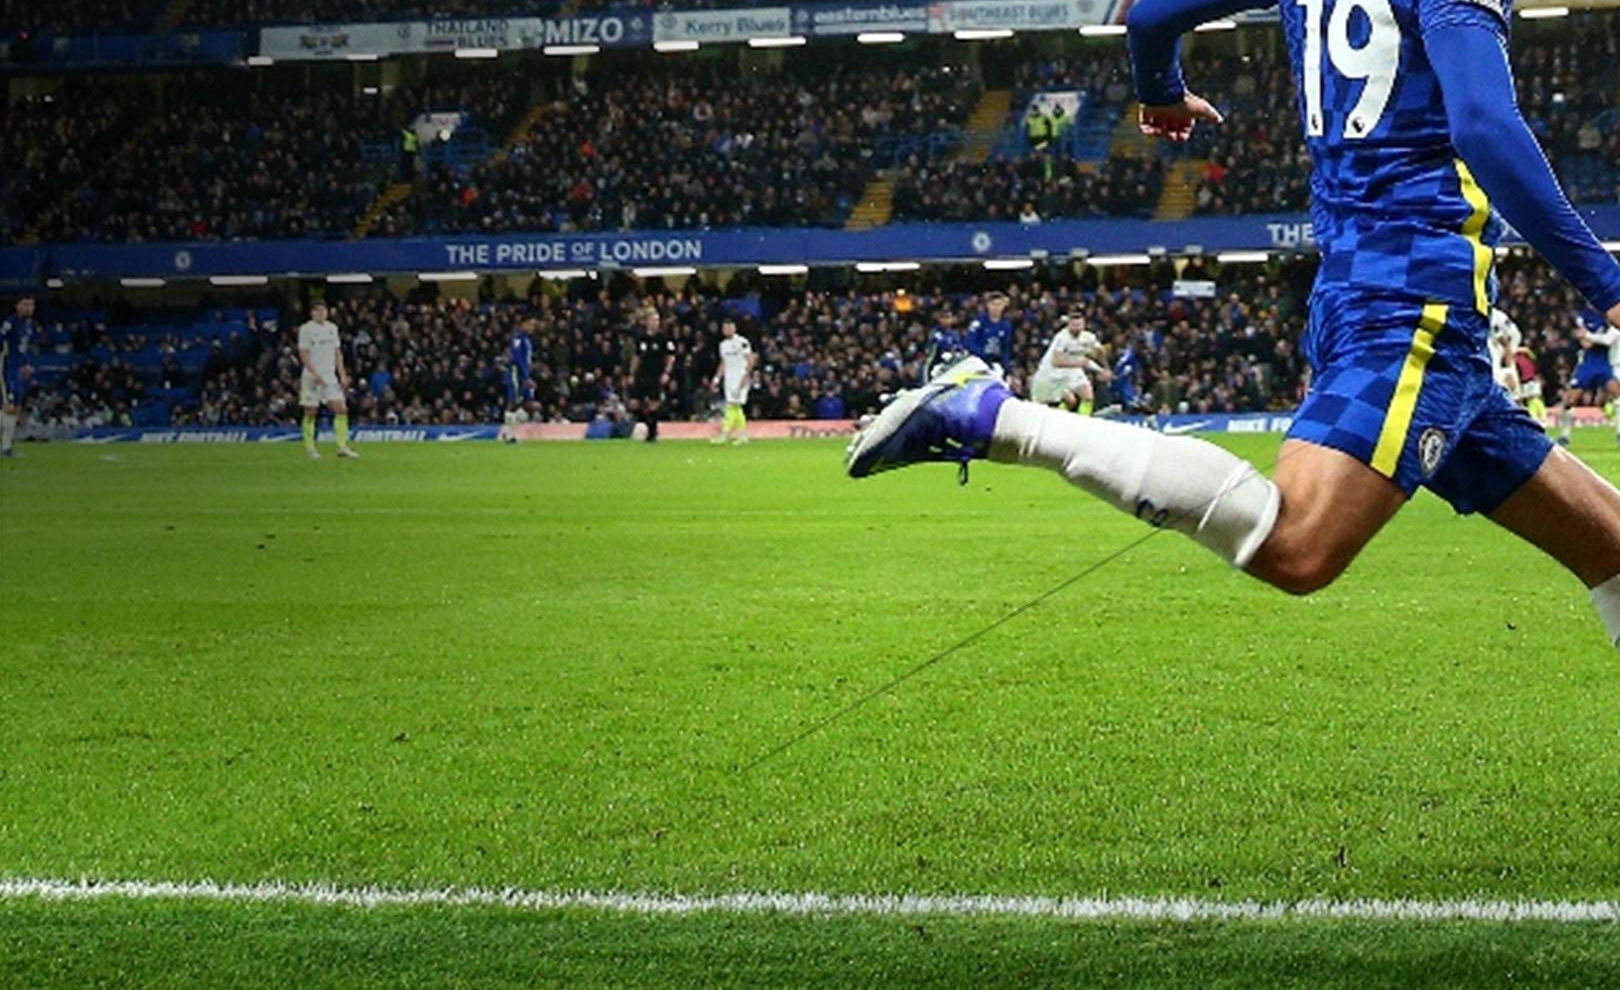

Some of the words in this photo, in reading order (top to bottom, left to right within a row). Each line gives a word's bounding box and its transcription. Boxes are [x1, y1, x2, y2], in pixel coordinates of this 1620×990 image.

[545, 17, 623, 43] MIZO
[446, 244, 489, 264] THE
[497, 242, 566, 263] PRIDE
[572, 242, 595, 255] OF
[601, 239, 702, 260] LONDON
